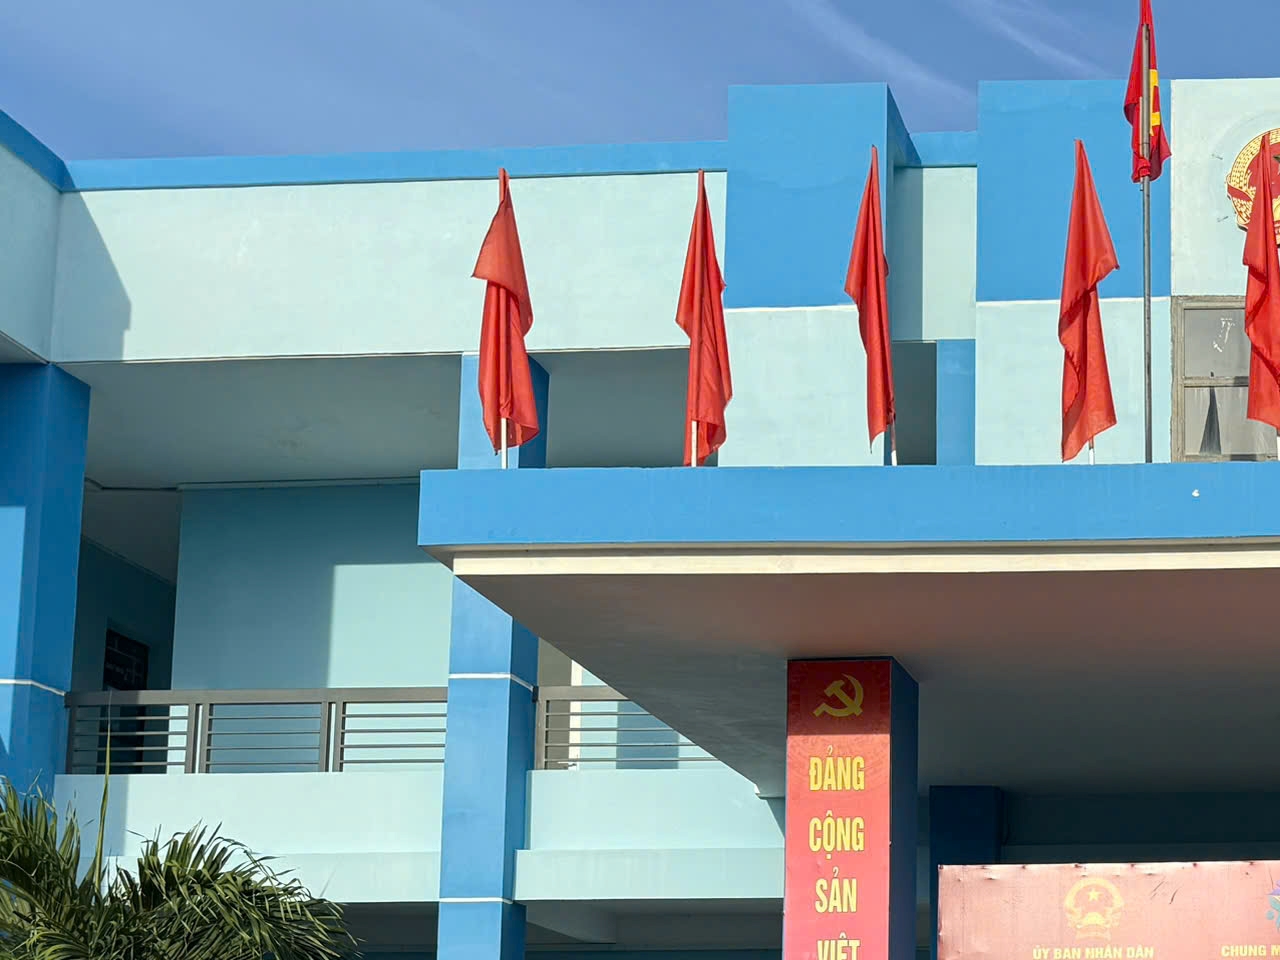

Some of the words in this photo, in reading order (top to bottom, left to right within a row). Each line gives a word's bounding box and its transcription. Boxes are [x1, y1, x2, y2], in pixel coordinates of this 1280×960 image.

[808, 743, 865, 791] ĐẢNG
[808, 810, 865, 860] CỘNG
[815, 866, 857, 913] SẢN
[1032, 944, 1050, 960] ỦY
[1053, 946, 1083, 960] BAN
[1085, 944, 1122, 959] NHÂN
[1126, 945, 1154, 958] DÂN
[1220, 944, 1267, 957] CHUNG
